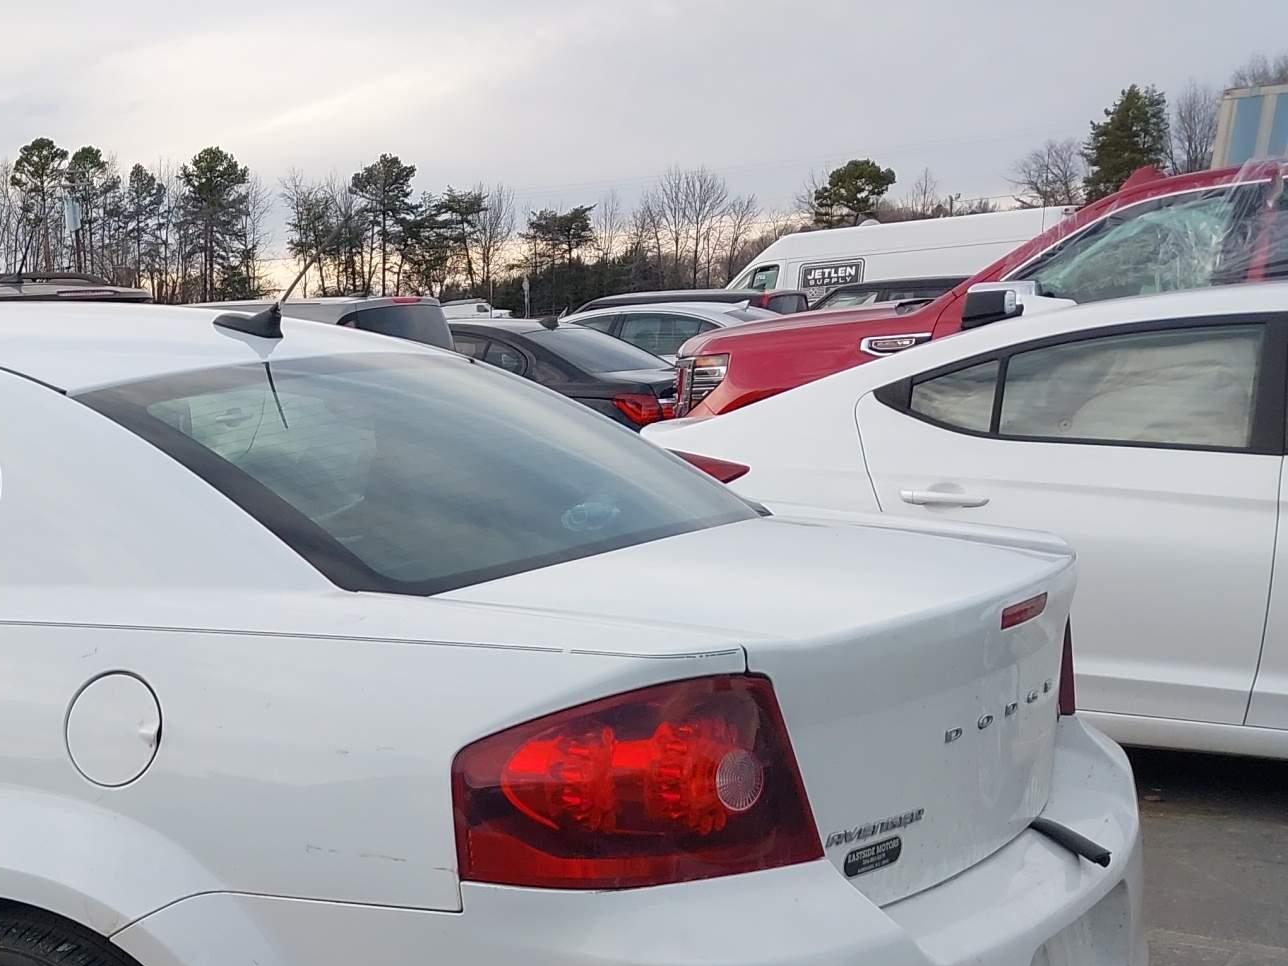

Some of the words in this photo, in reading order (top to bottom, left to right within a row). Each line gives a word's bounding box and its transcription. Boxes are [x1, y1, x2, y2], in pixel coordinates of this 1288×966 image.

[807, 266, 856, 279] JETLEN
[809, 276, 852, 286] SUPPLY
[944, 679, 1052, 743] DODGE
[847, 844, 876, 864] EASTSIDE
[876, 838, 899, 854] MOTORS
